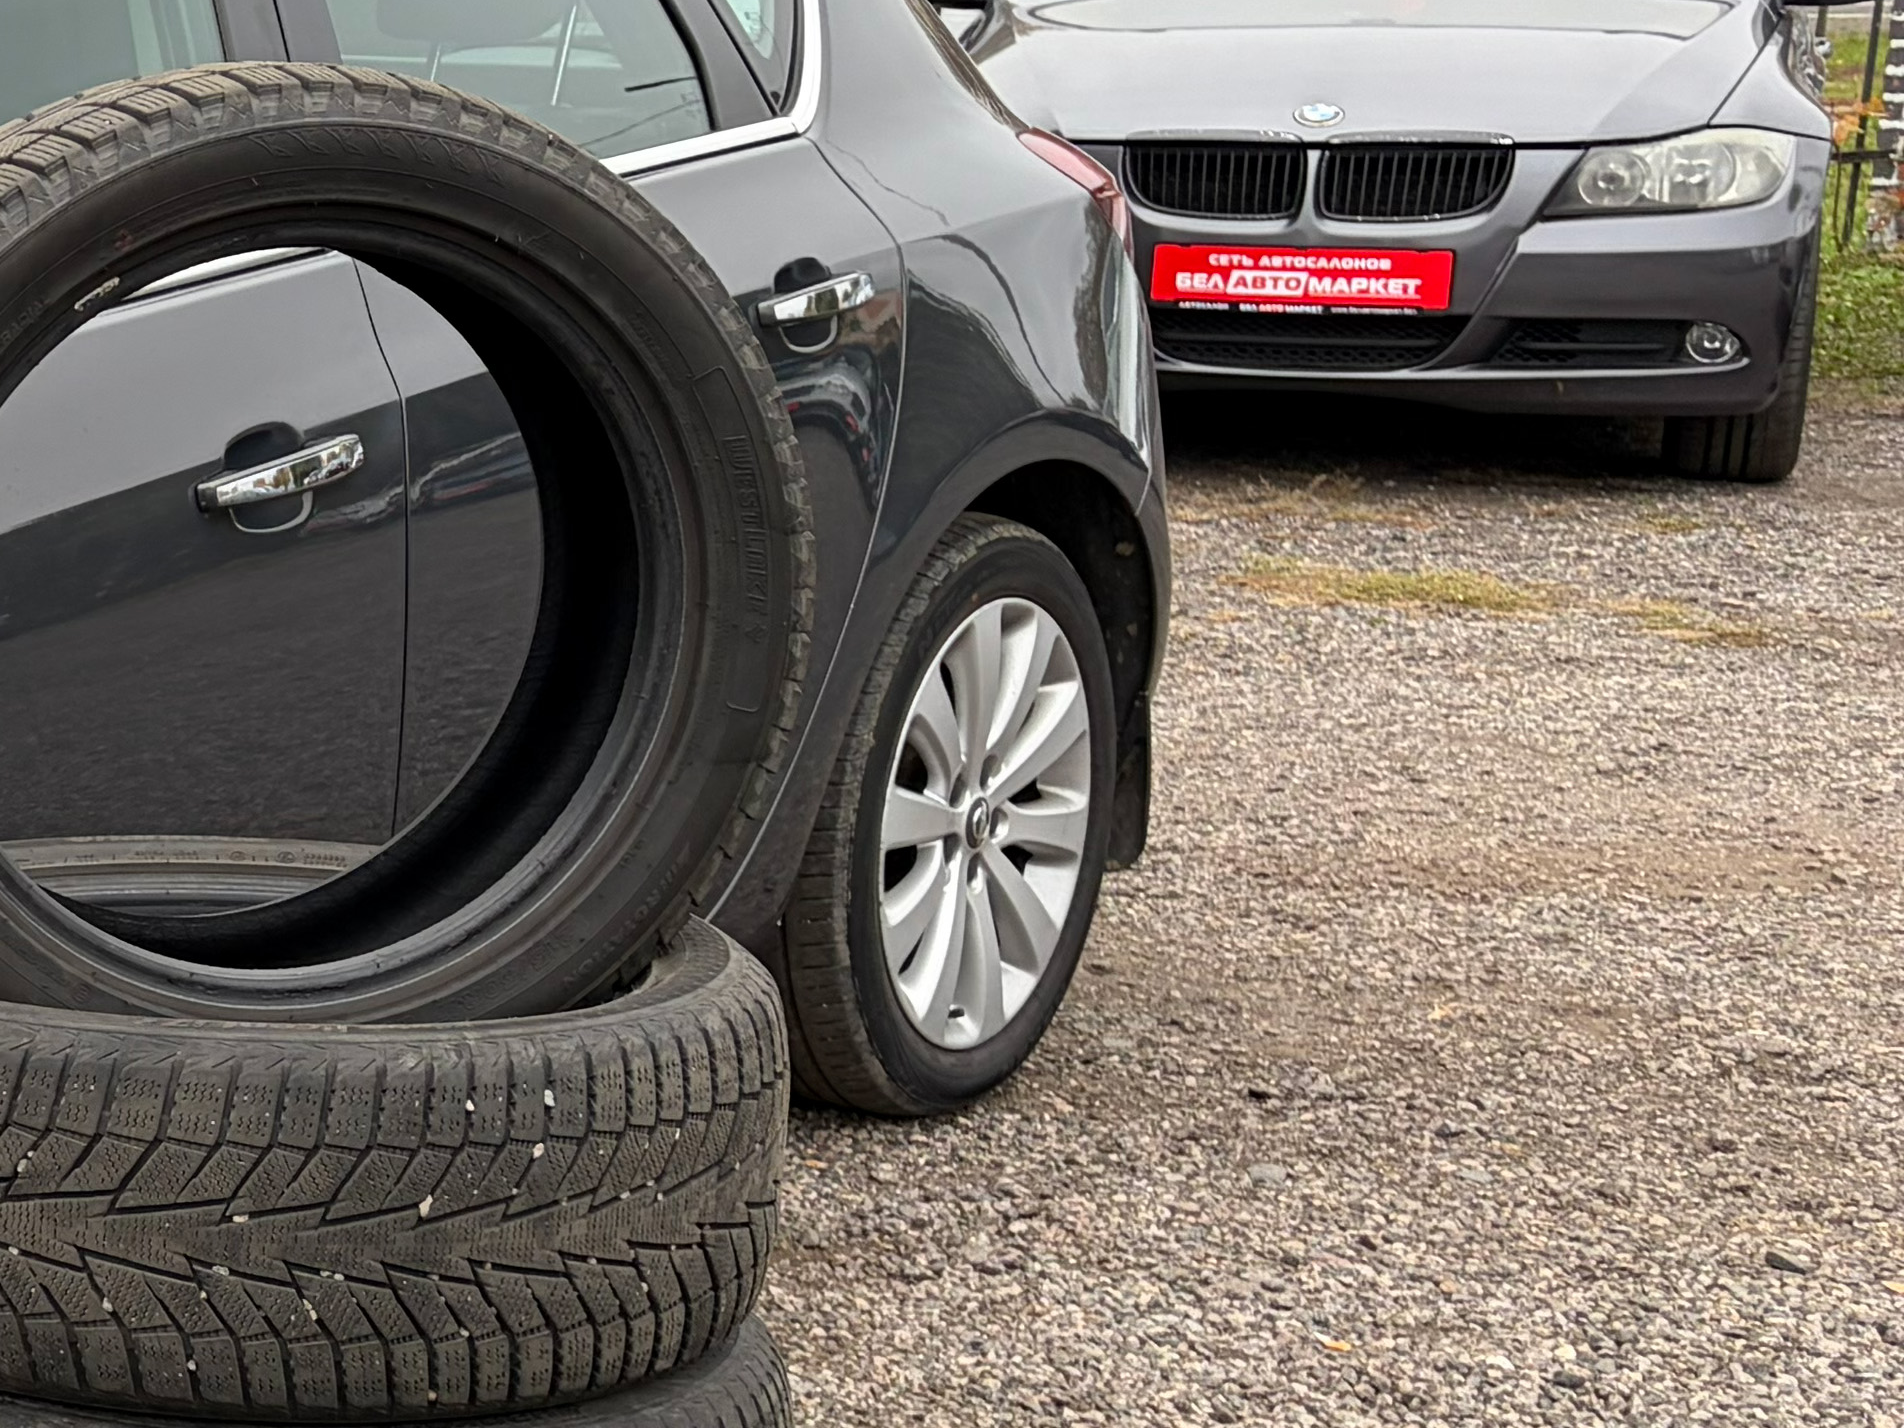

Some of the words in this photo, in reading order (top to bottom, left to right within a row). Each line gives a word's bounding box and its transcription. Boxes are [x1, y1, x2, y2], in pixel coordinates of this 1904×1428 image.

[1208, 253, 1254, 268] СЕТЬ
[1258, 255, 1392, 271] АВТОСАЛОНОВ
[1175, 272, 1225, 291] БЕЛ
[1233, 274, 1302, 293] АВТО
[1308, 275, 1422, 296] МАРКЕТ
